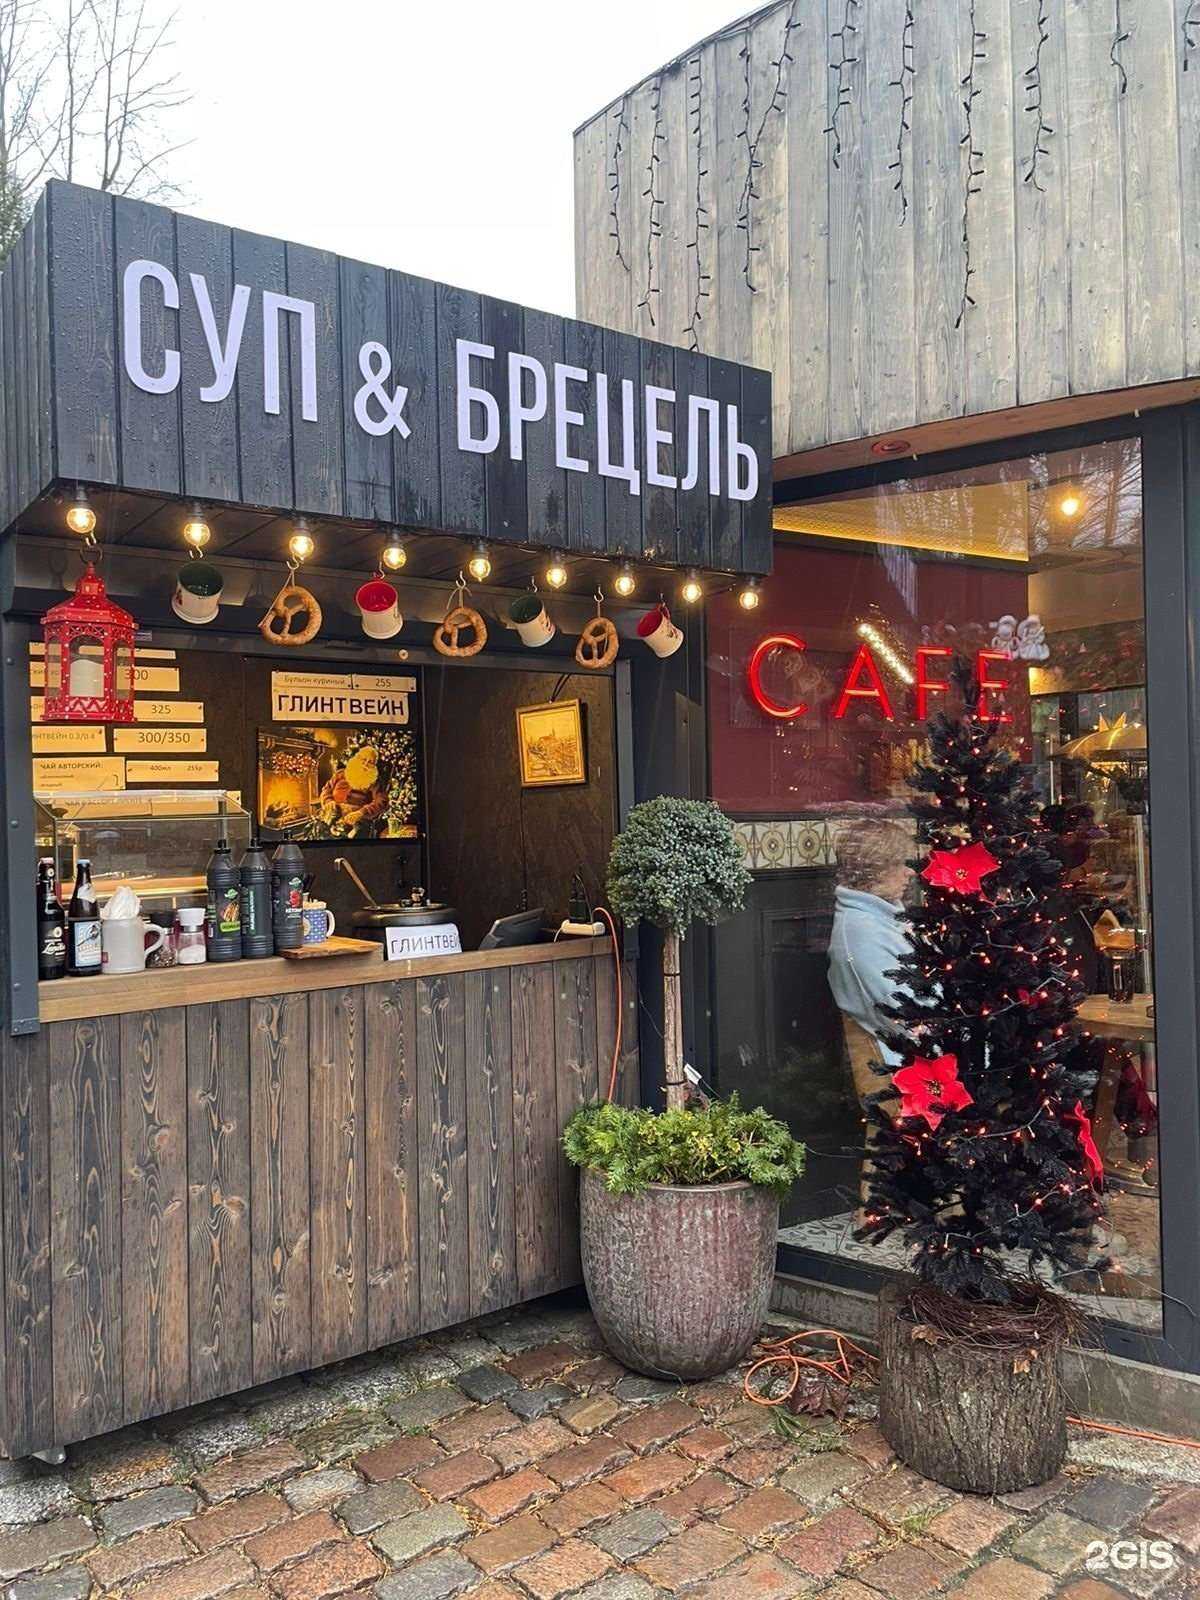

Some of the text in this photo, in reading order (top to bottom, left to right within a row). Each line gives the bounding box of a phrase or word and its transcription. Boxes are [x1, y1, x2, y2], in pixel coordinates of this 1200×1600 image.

[124, 259, 759, 502] СУП & БРЕЦЕЛЬ
[375, 678, 392, 688] 255
[747, 632, 1013, 723] CAFE
[151, 704, 171, 715] 325
[277, 694, 404, 716] ГЛИНТВЕЙН
[138, 731, 191, 746] 300/350
